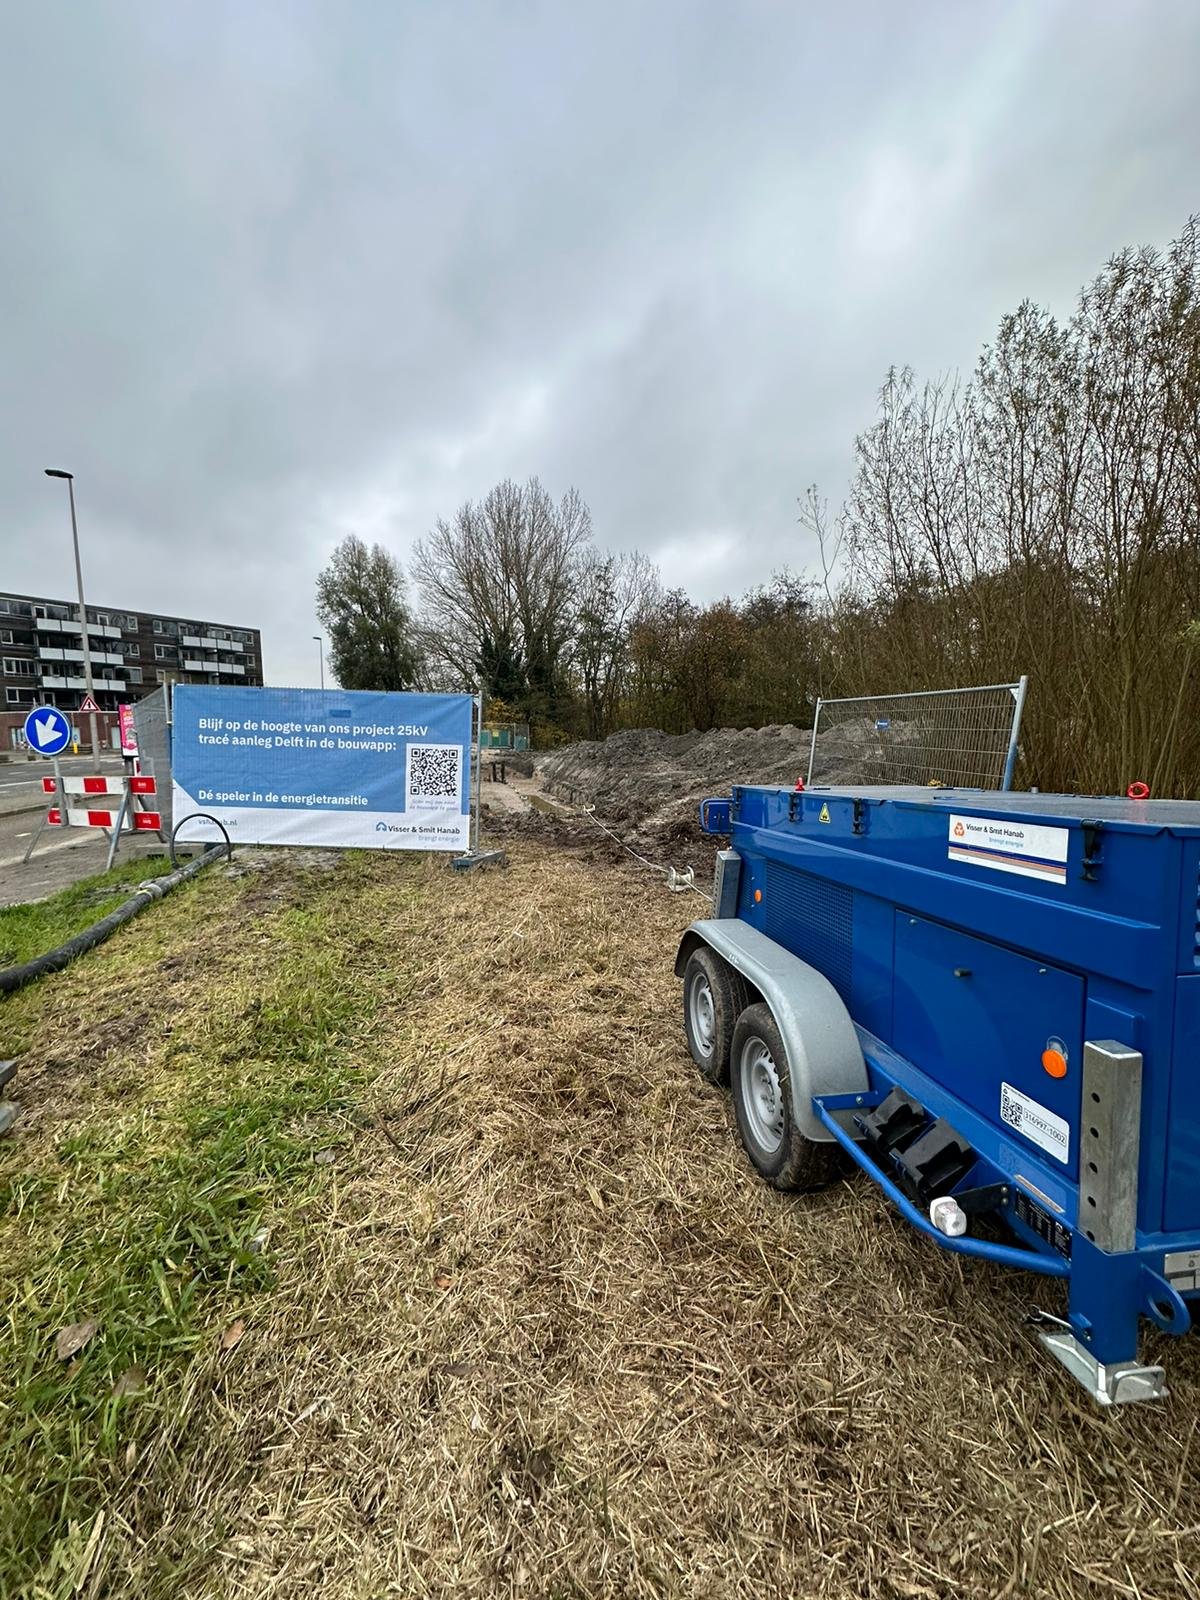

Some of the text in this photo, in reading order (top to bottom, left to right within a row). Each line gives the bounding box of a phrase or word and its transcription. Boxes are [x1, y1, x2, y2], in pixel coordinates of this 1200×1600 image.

[199, 719, 428, 737] Blijf op de hoogte van ons project 25kV
[199, 733, 397, 752] tracé aanleg Delft in de bouwapp:
[198, 789, 368, 806] Dé speler in de energietransitie
[388, 825, 410, 833] Visser
[437, 826, 460, 834] Hanab
[966, 823, 1025, 838] Visser & Smit Hanab
